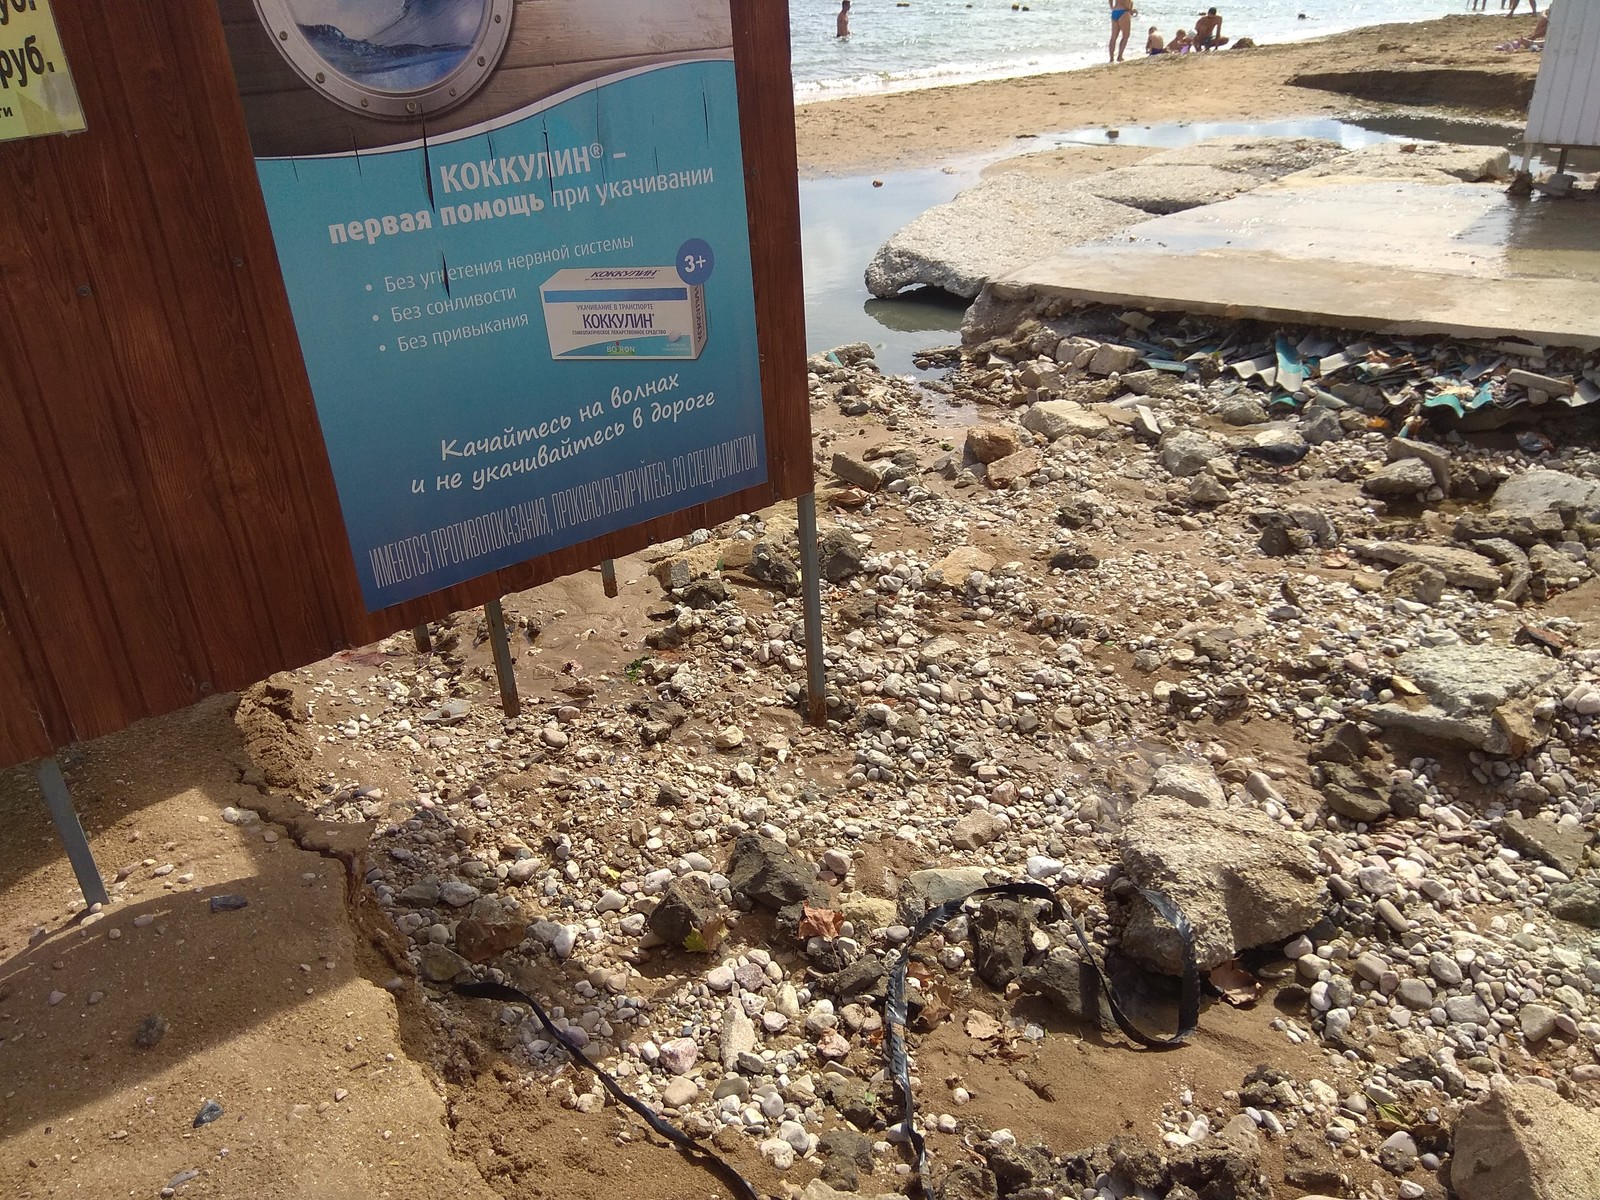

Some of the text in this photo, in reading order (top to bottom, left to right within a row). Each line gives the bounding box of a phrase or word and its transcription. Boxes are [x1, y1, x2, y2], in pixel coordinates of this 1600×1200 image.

[328, 167, 715, 245] первая помощь при укачивании
[384, 235, 634, 293] Без угнетения нервной системы
[684, 255, 707, 273] 3+
[391, 287, 517, 323] Без сонливости
[397, 313, 529, 353] Без привыкания
[576, 303, 613, 311] УКАЧИВАНИЕ
[619, 303, 654, 311] ТРАНСПОРТЕ
[411, 391, 715, 493] и не укачивайтесь в дороге
[441, 373, 680, 461] Качайтесь на волнах
[369, 433, 759, 589] ИМЕЮТСЯ ПРОТИВОПОКАЗАНИЯ, ПРОКОНСУЛЬТИРУЙТЕСЬ СО СПЕЦИАЛИСТОМ
